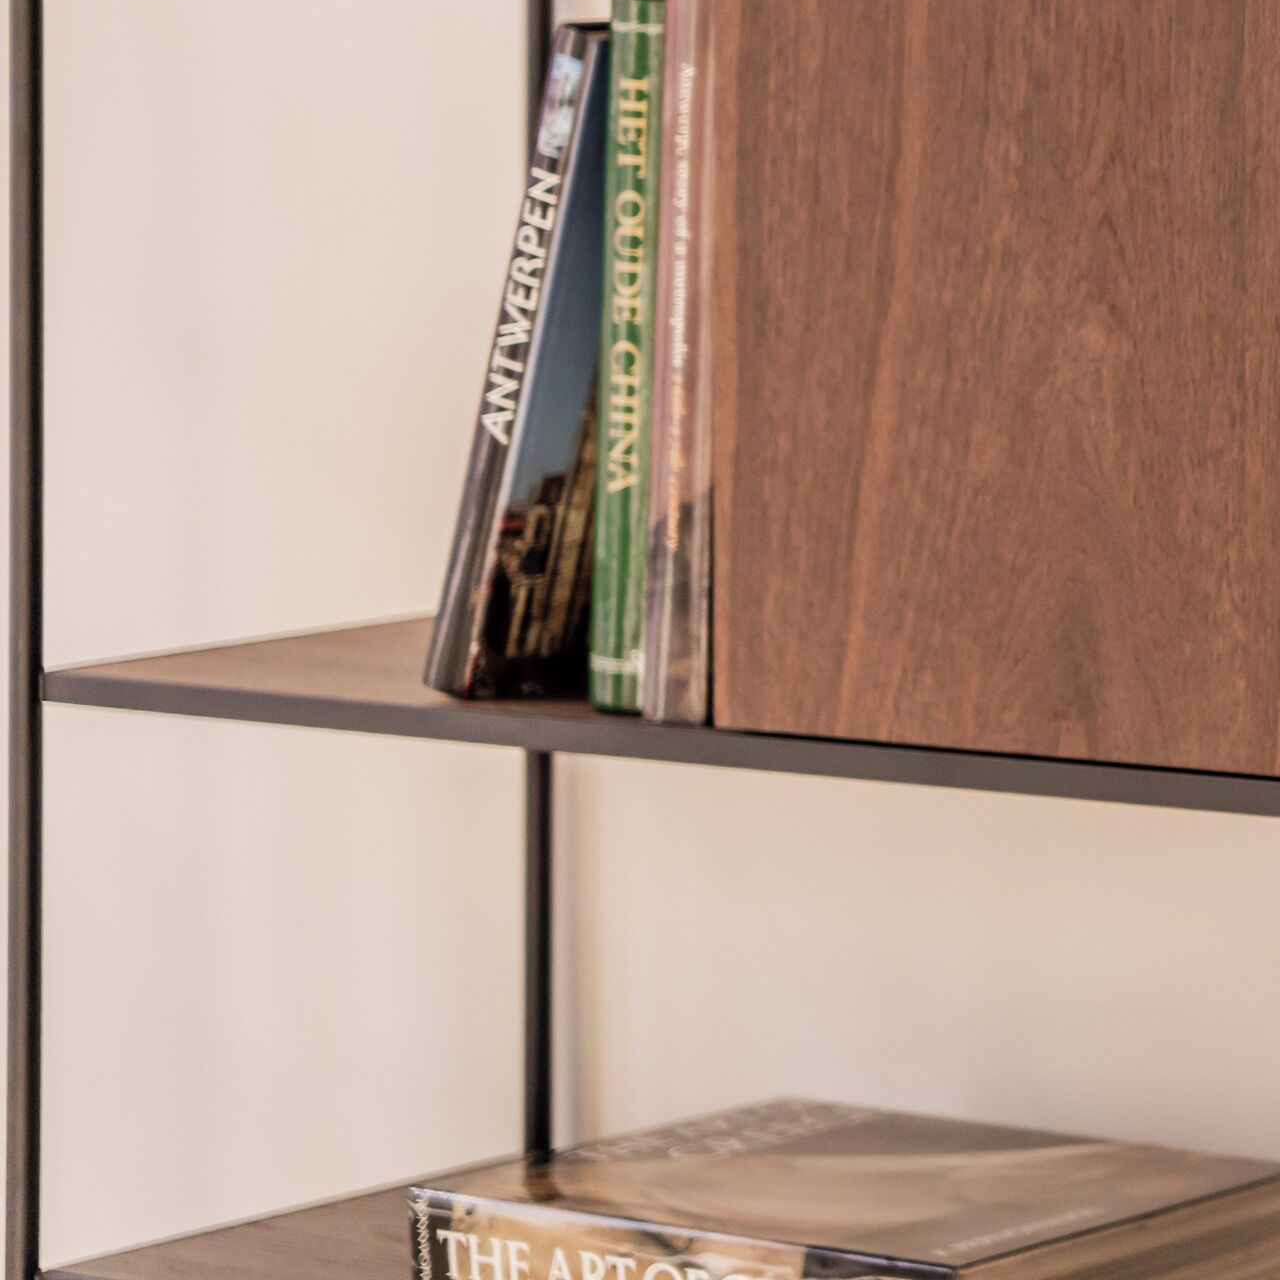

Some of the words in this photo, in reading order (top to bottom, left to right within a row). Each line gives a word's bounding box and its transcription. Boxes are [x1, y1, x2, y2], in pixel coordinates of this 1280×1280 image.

[616, 77, 650, 178] HET
[481, 166, 561, 447] ANTWERPEN
[613, 190, 645, 326] OUDE
[607, 339, 642, 495] CHINA
[436, 1228, 531, 1280] THE
